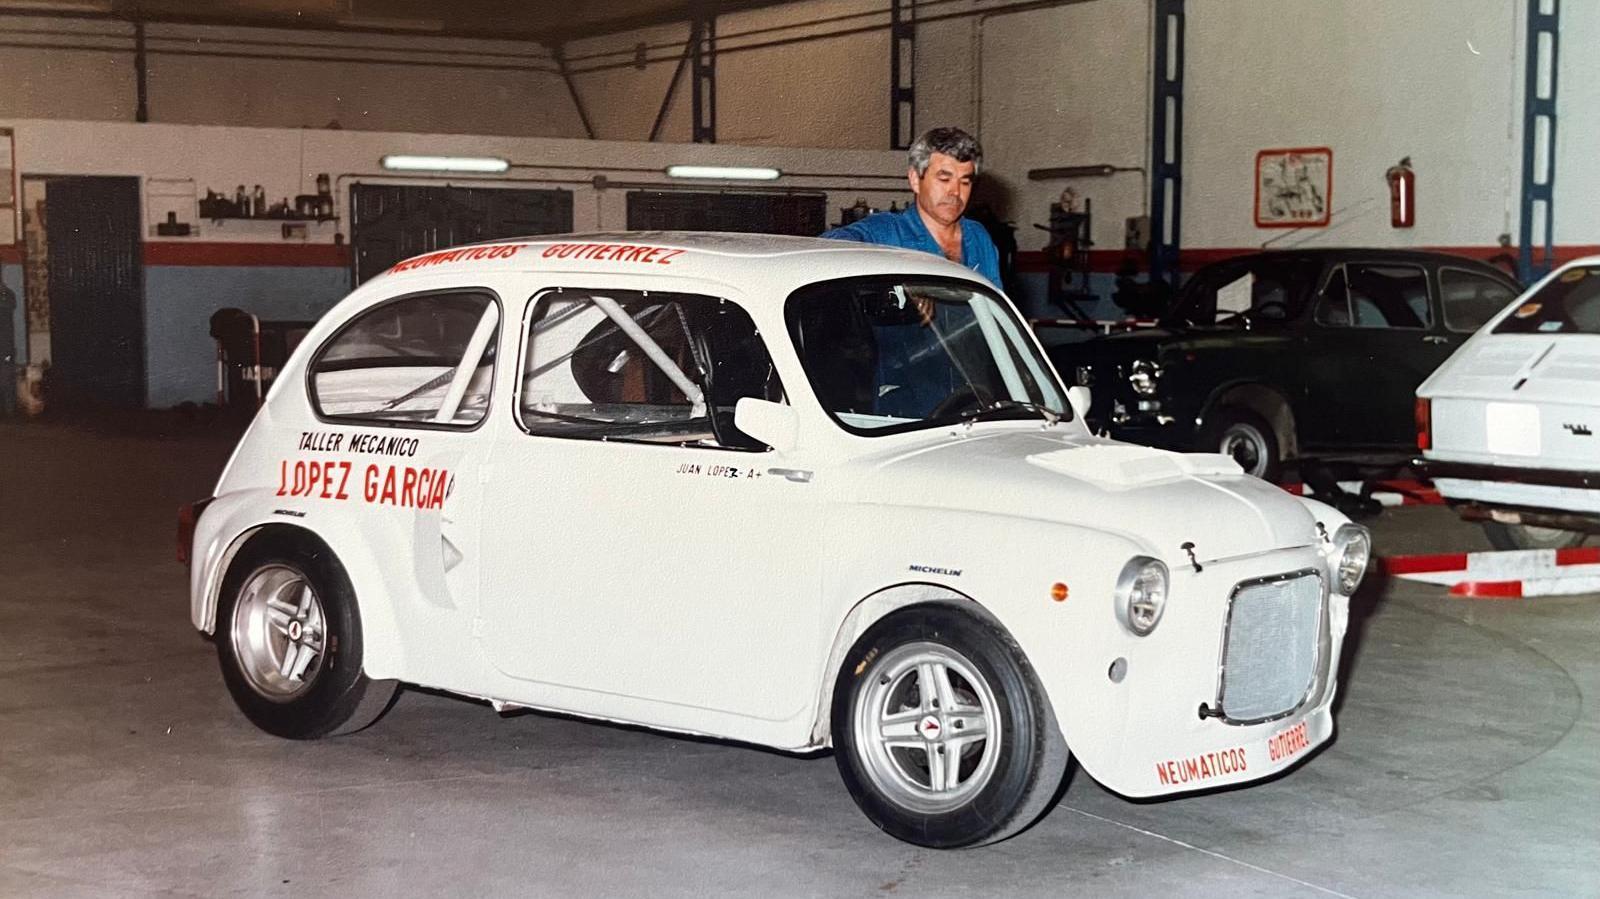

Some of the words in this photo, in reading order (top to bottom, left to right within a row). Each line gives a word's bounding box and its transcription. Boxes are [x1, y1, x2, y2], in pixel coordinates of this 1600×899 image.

[386, 245, 527, 275] NEUMATICOS
[541, 244, 685, 265] GUTIERREZ
[299, 432, 344, 451] TALLER
[348, 434, 420, 457] MECANICO
[676, 464, 702, 475] JUAN
[276, 460, 352, 500] LOPEZ
[364, 464, 447, 510] GARCIA
[909, 564, 962, 577] MICHELIN
[1156, 747, 1247, 785] NEUMATICOS
[1267, 722, 1310, 762] GUTIERREZ
